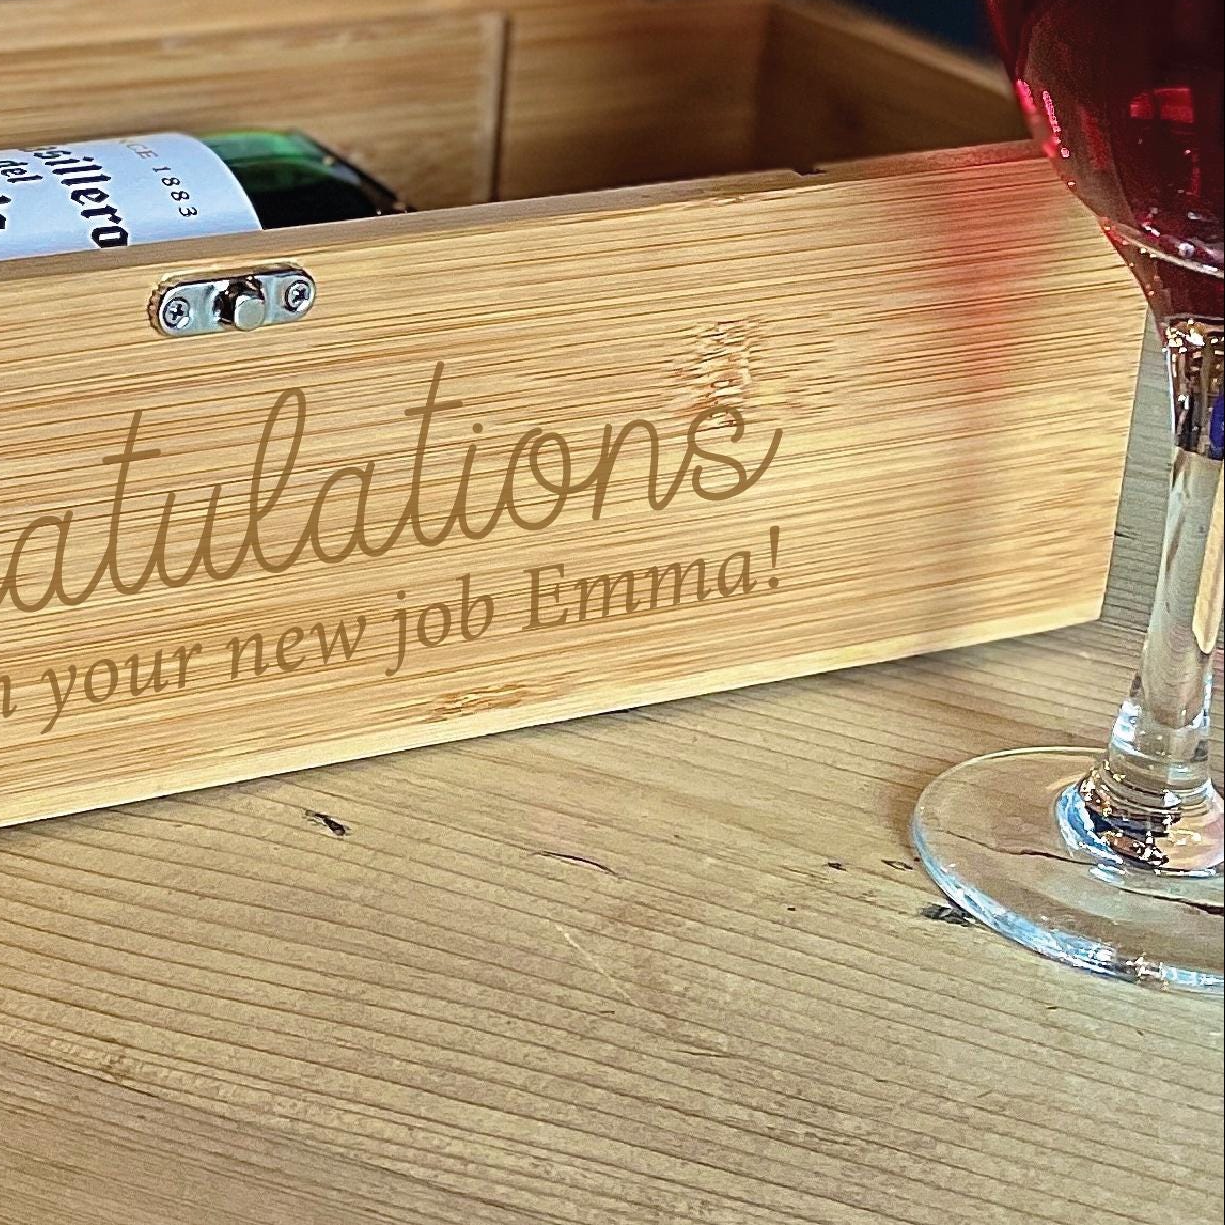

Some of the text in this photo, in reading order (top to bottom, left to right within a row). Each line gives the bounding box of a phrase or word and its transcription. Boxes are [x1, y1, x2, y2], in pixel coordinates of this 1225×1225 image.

[26, 147, 129, 248] sillero
[152, 166, 197, 216] 1883
[40, 643, 203, 735] your
[225, 614, 367, 680] new
[385, 573, 494, 677] job
[522, 525, 781, 631] Emma!
